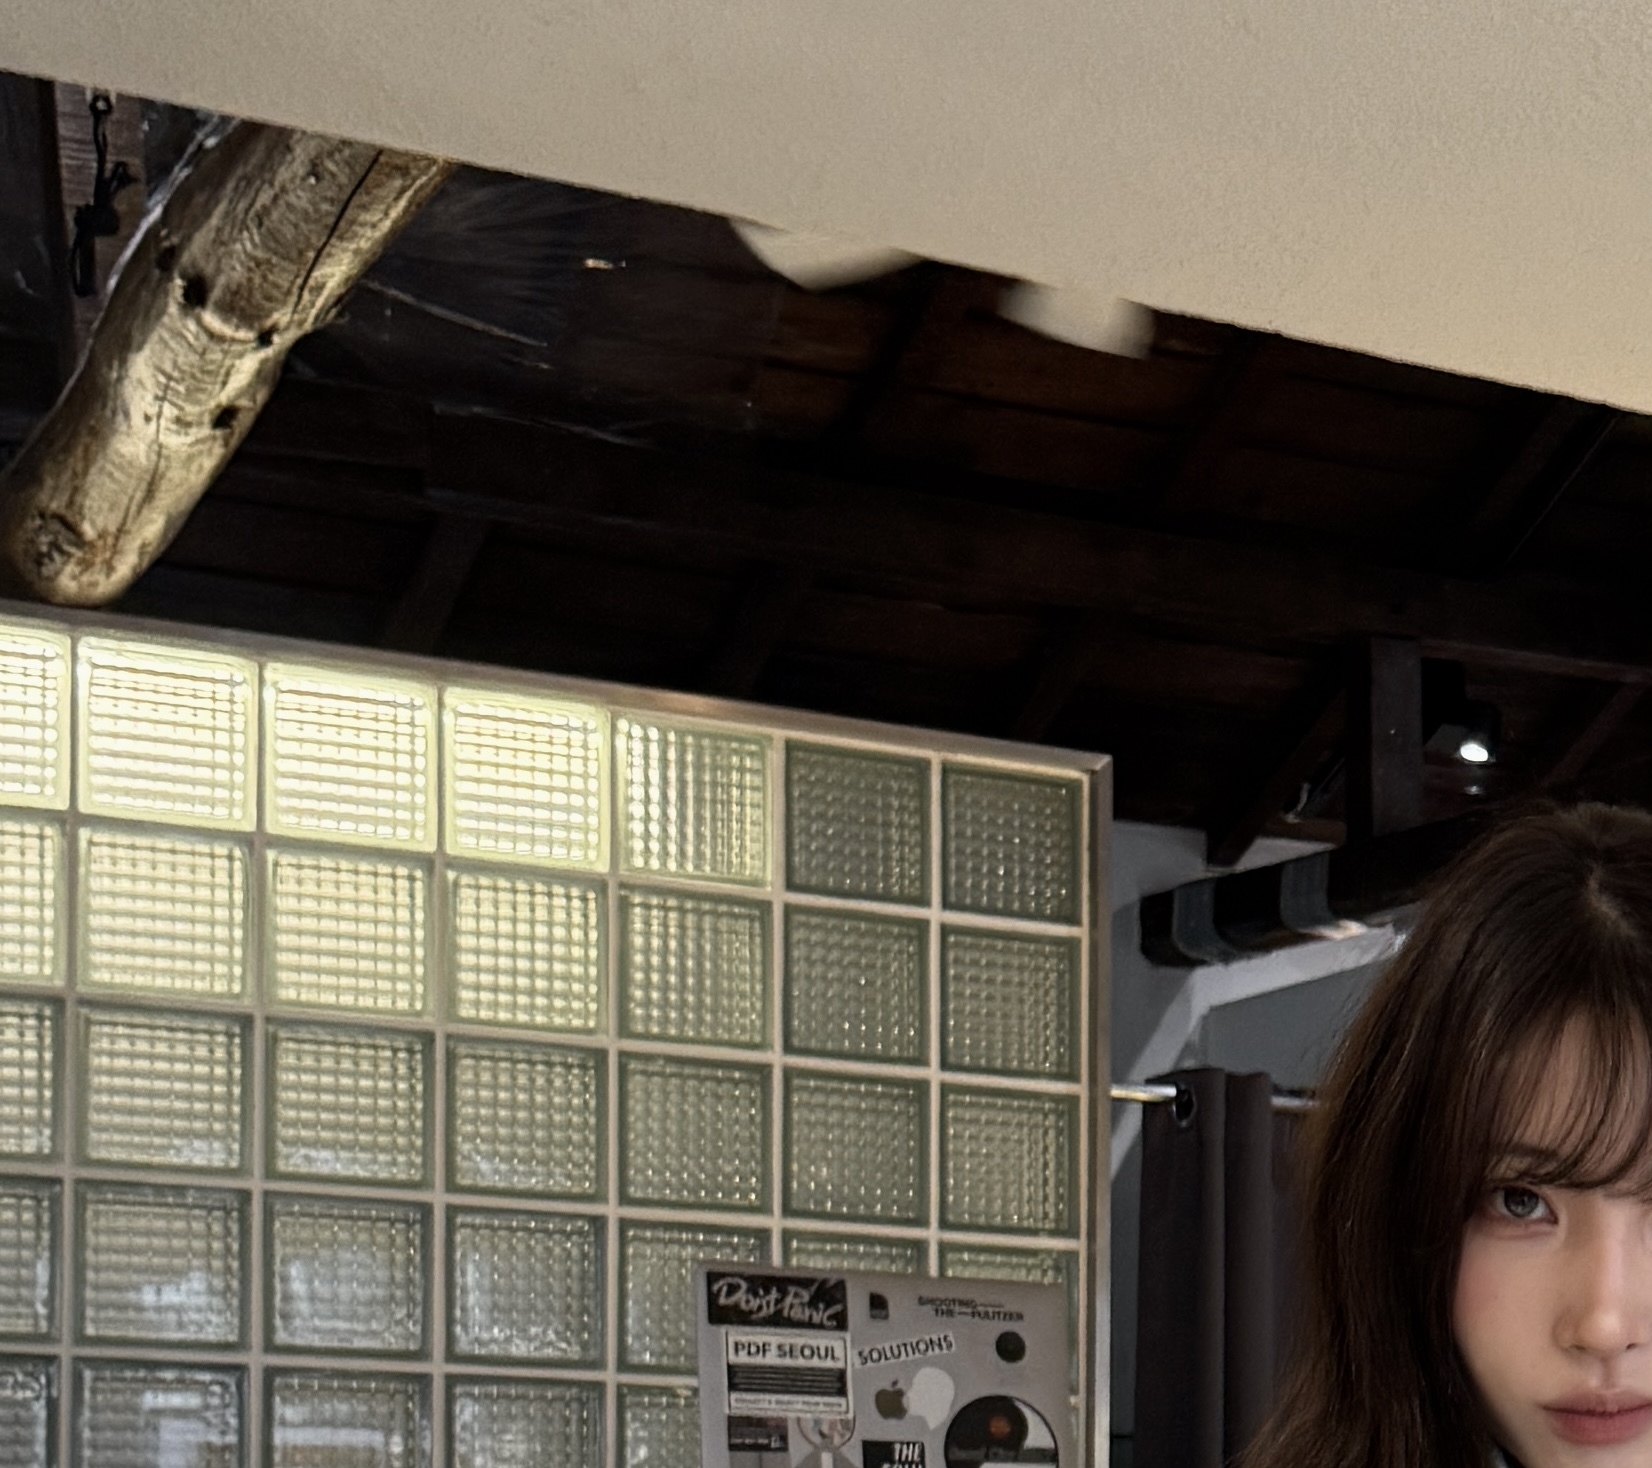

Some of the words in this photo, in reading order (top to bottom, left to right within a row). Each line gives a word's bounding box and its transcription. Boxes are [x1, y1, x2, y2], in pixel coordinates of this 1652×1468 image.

[733, 1340, 772, 1359] PDF
[775, 1342, 841, 1362] SEOUL
[857, 1334, 954, 1366] SOLUTIONS
[893, 1442, 922, 1461] THE
